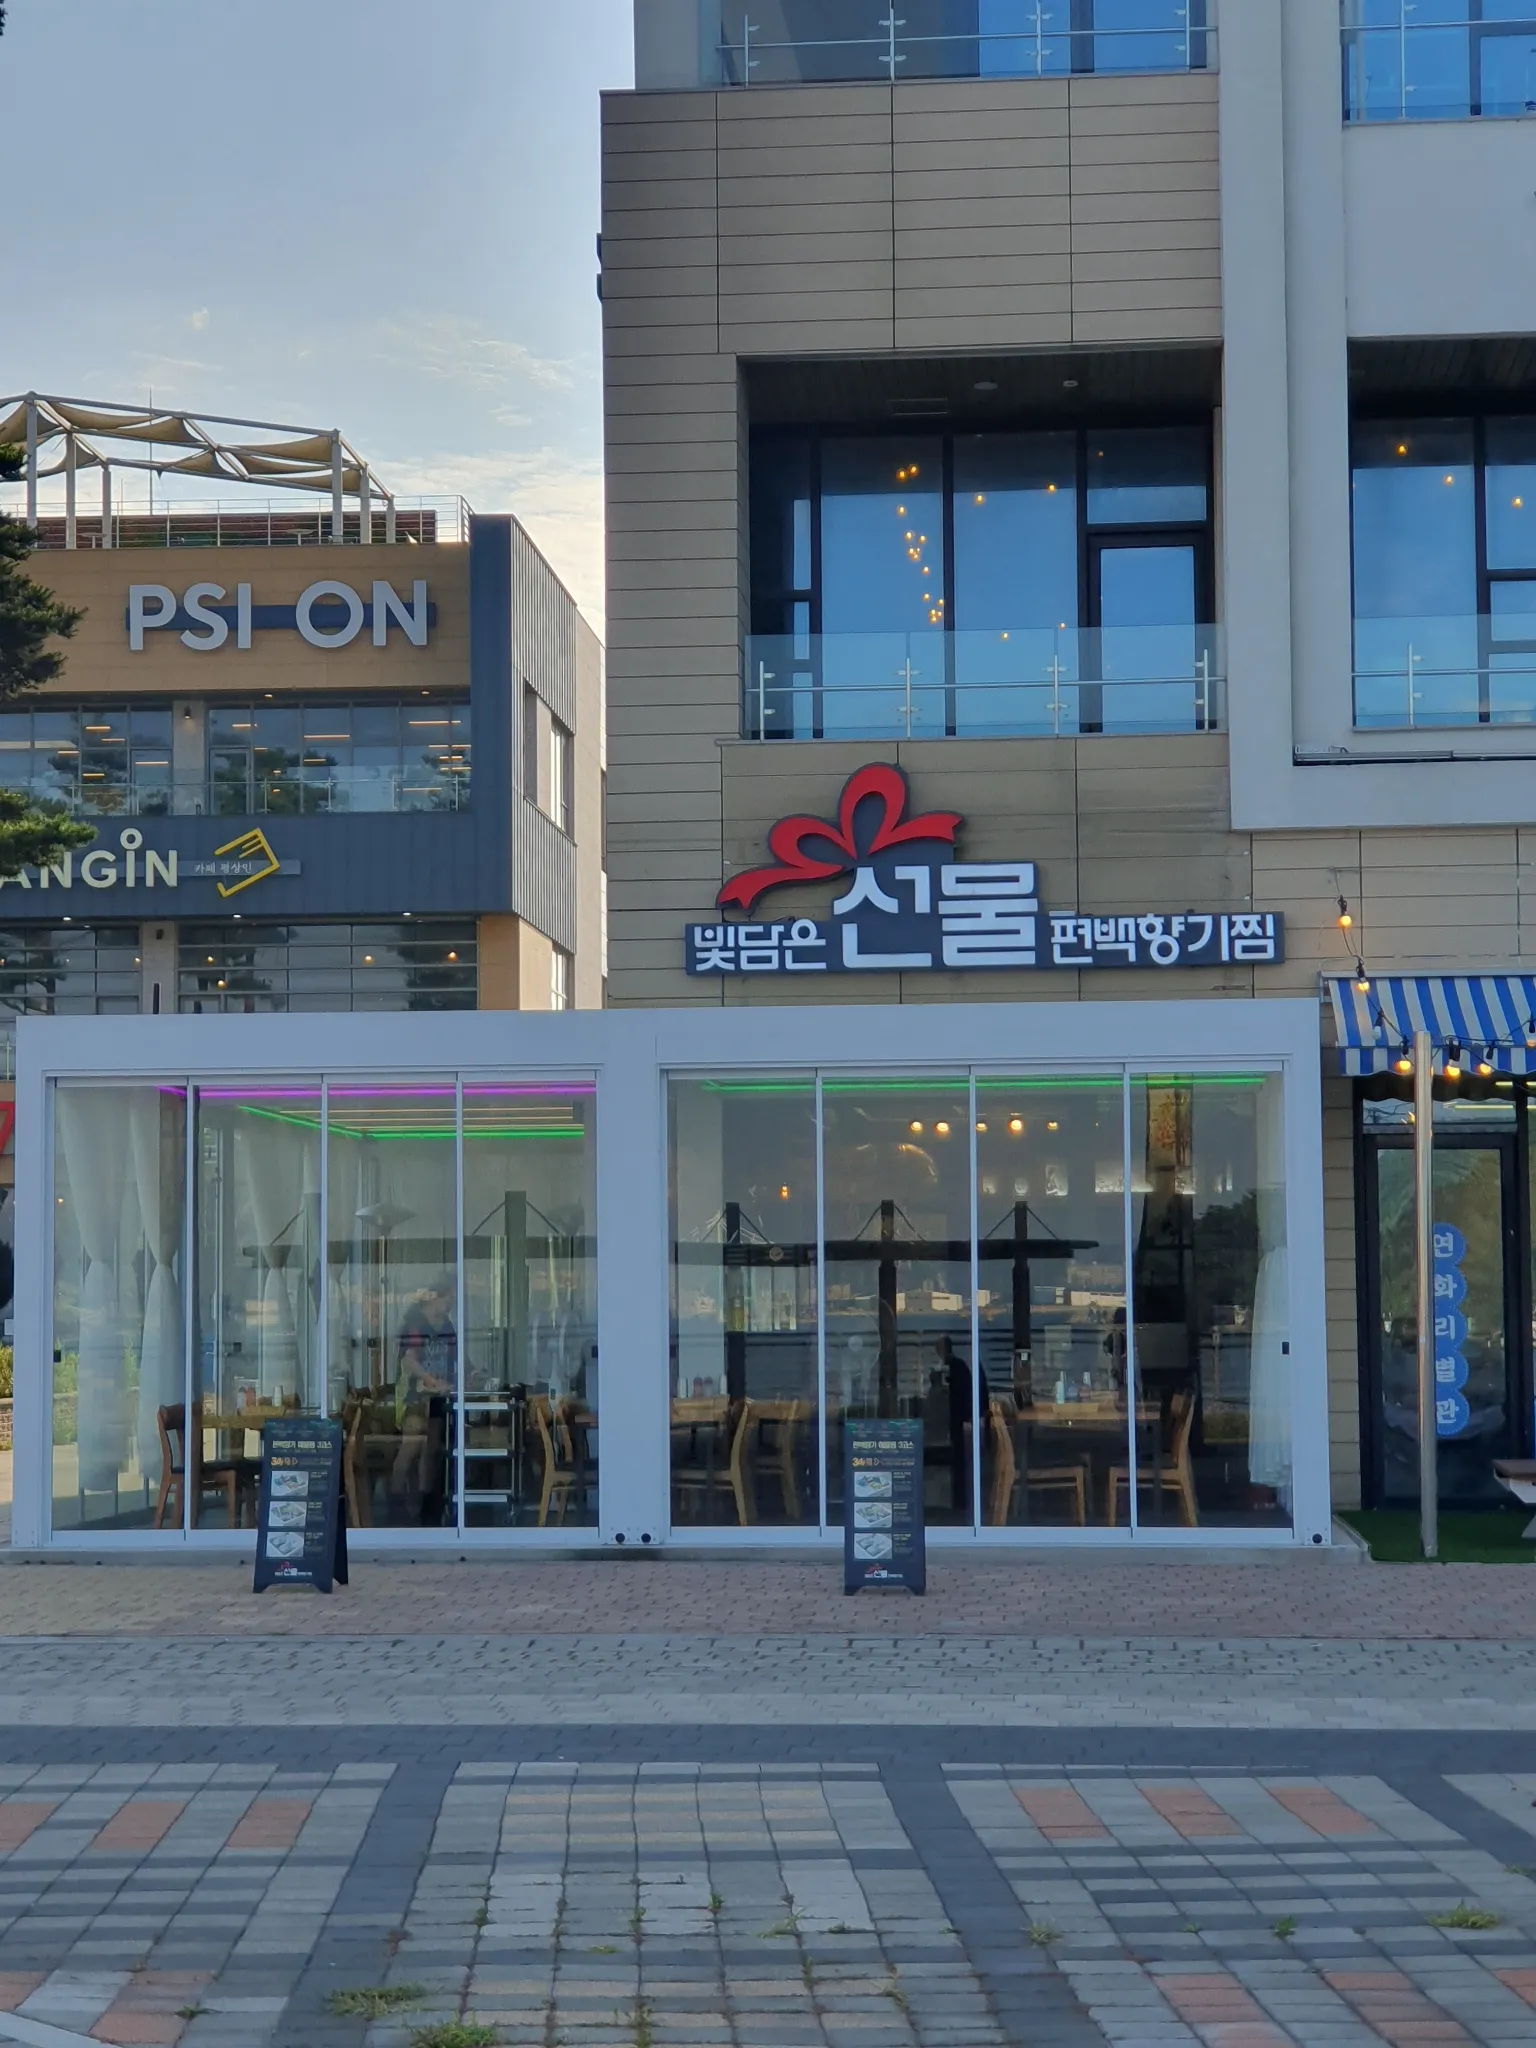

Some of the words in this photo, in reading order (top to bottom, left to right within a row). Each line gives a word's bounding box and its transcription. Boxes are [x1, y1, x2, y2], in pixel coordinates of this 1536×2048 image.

[129, 583, 251, 650] PSI
[296, 580, 427, 648] ON
[194, 863, 216, 874] 카페
[220, 862, 252, 874] 평상인
[694, 918, 827, 971] 빛담은
[833, 862, 1038, 968] 선물
[1049, 911, 1275, 965] 편백향기찜
